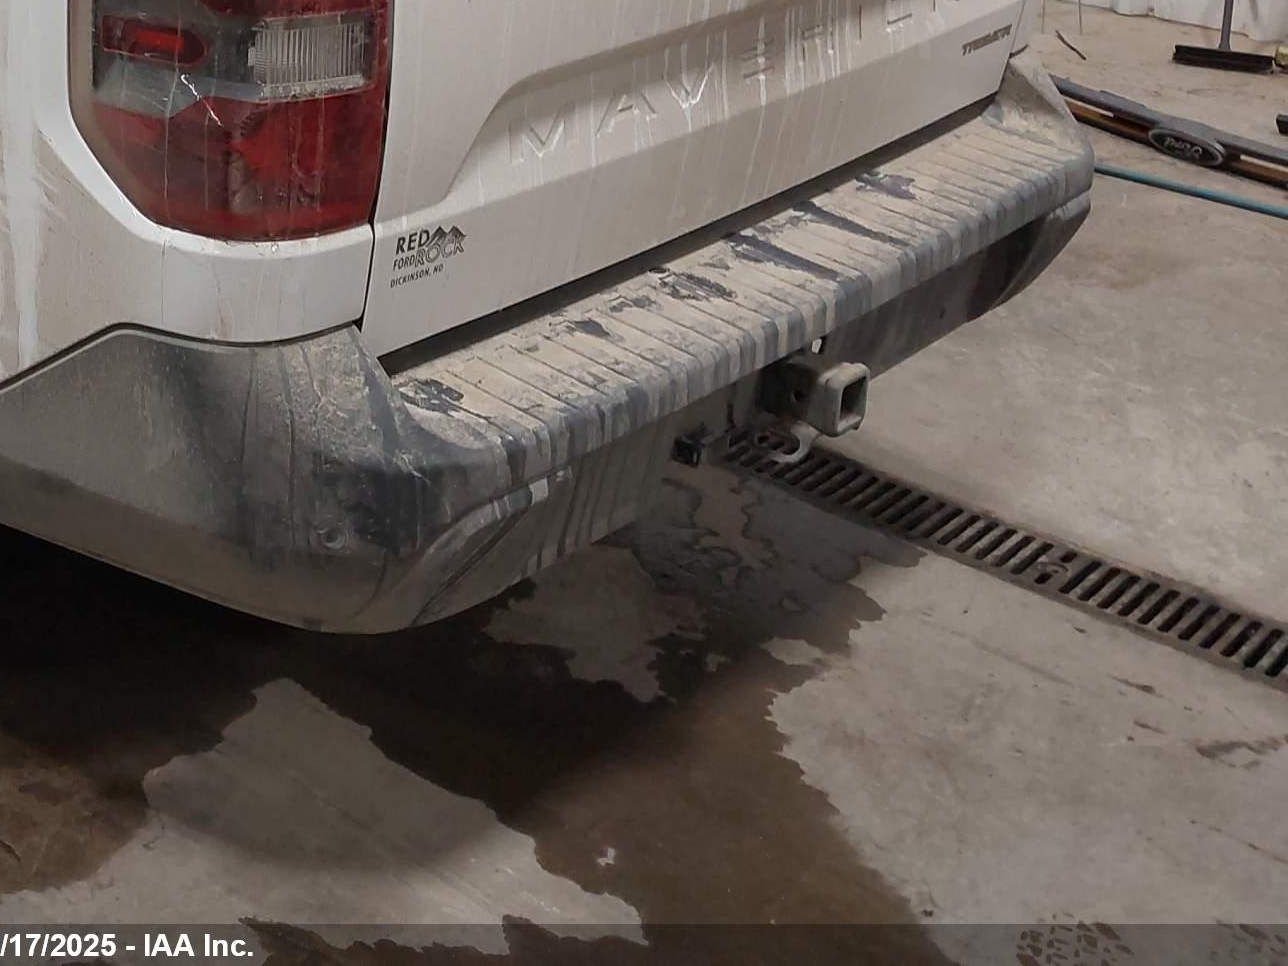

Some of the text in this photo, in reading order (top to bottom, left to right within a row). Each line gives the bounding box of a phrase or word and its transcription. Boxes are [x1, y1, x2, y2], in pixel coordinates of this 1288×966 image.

[393, 234, 464, 271] FORD ROCK
[396, 229, 430, 255] RED
[390, 263, 444, 289] DICKINSON, ND
